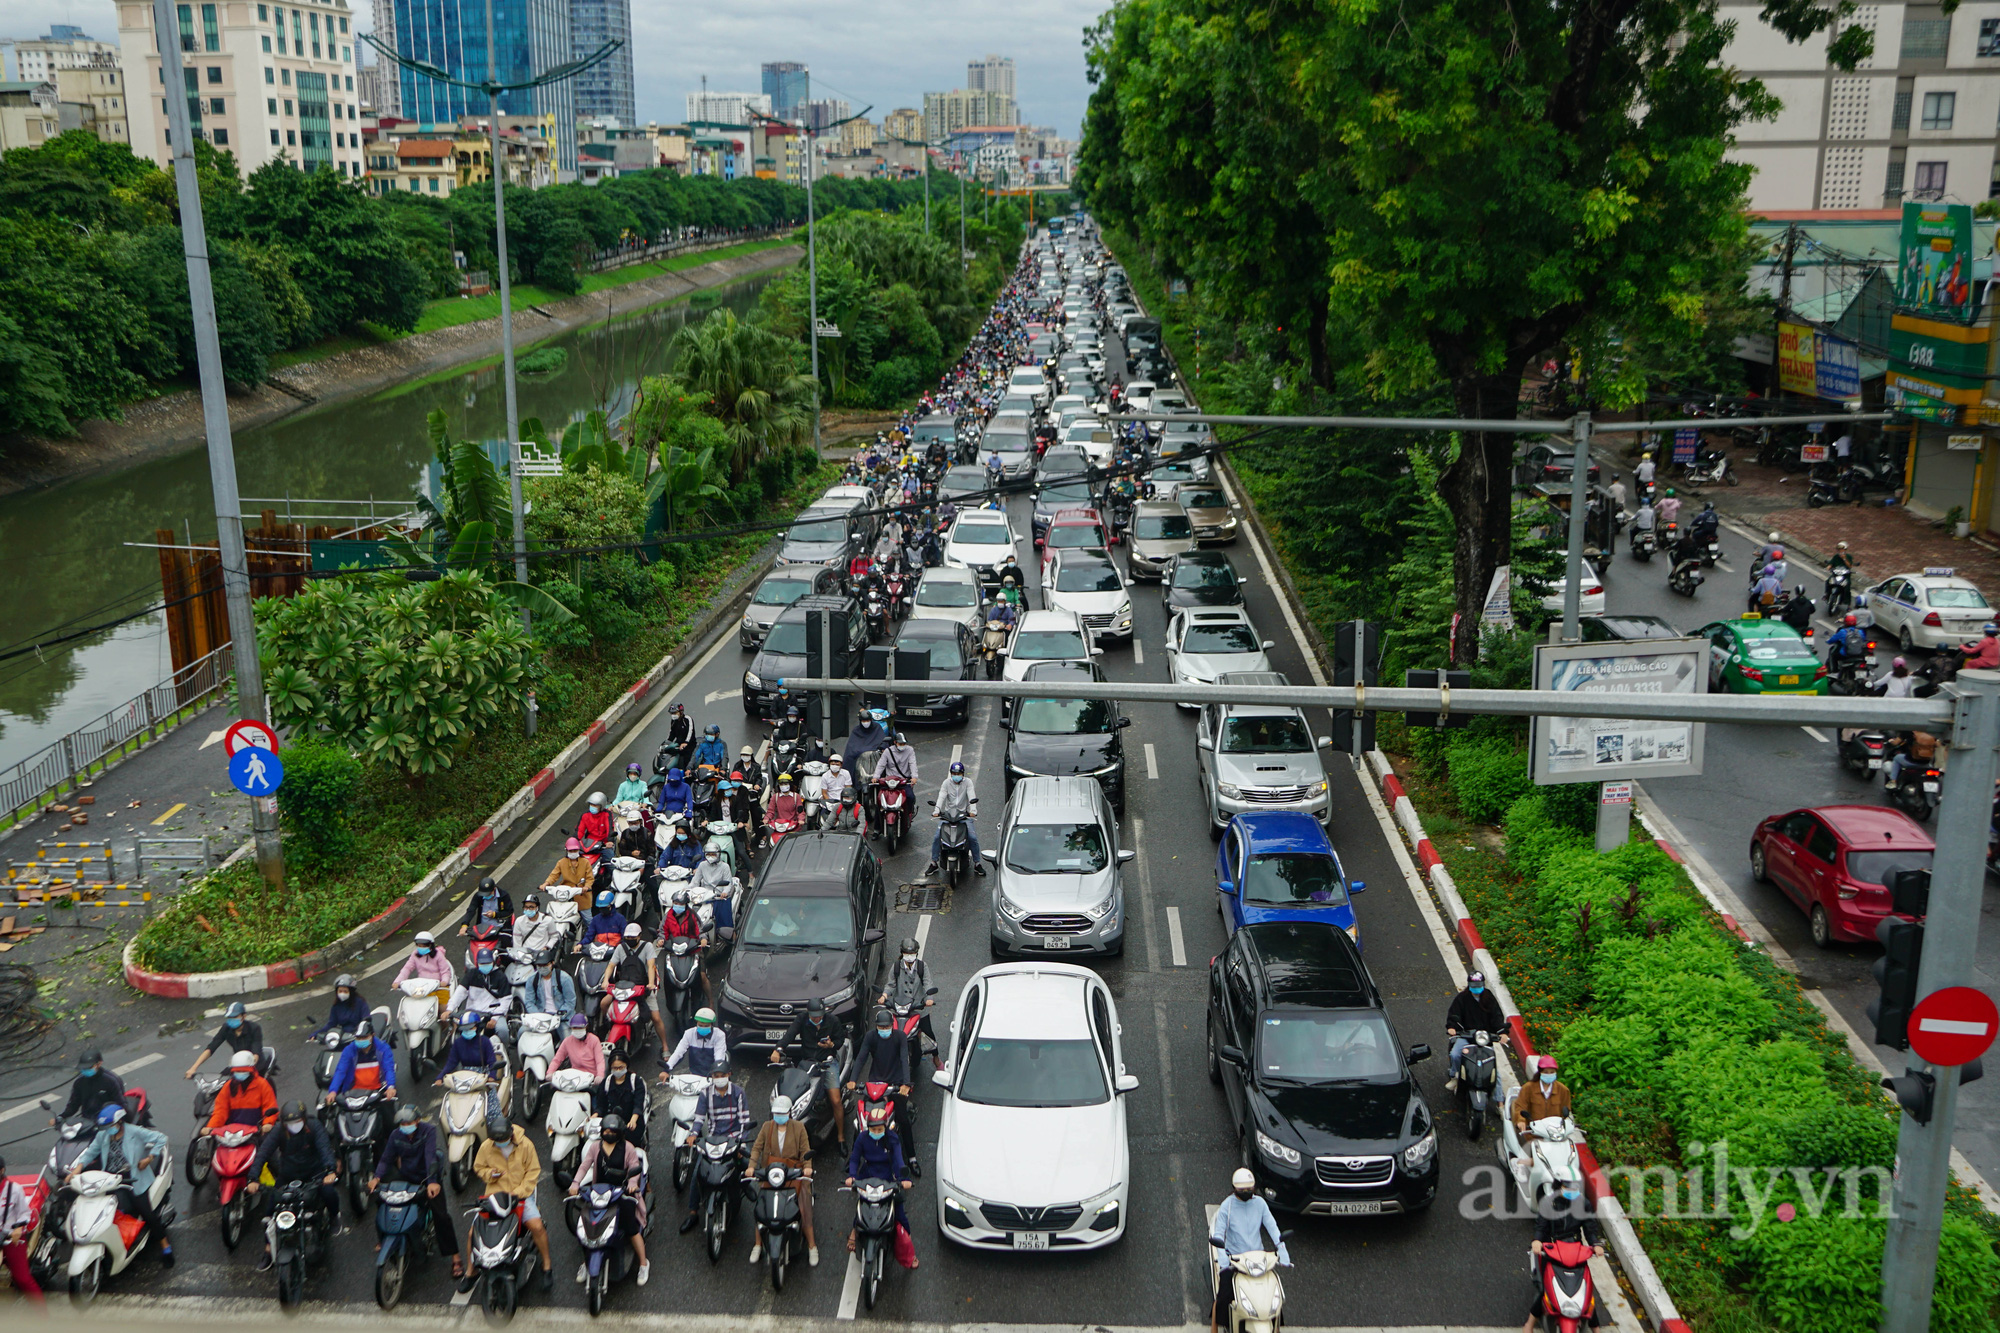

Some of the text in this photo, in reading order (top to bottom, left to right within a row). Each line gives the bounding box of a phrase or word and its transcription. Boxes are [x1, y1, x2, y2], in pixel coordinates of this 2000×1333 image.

[1780, 327, 1798, 352] PHỞ
[1577, 660, 1668, 675] LIÊN HỆ QUẢNG CÁO
[1025, 1233, 1039, 1241] 15A
